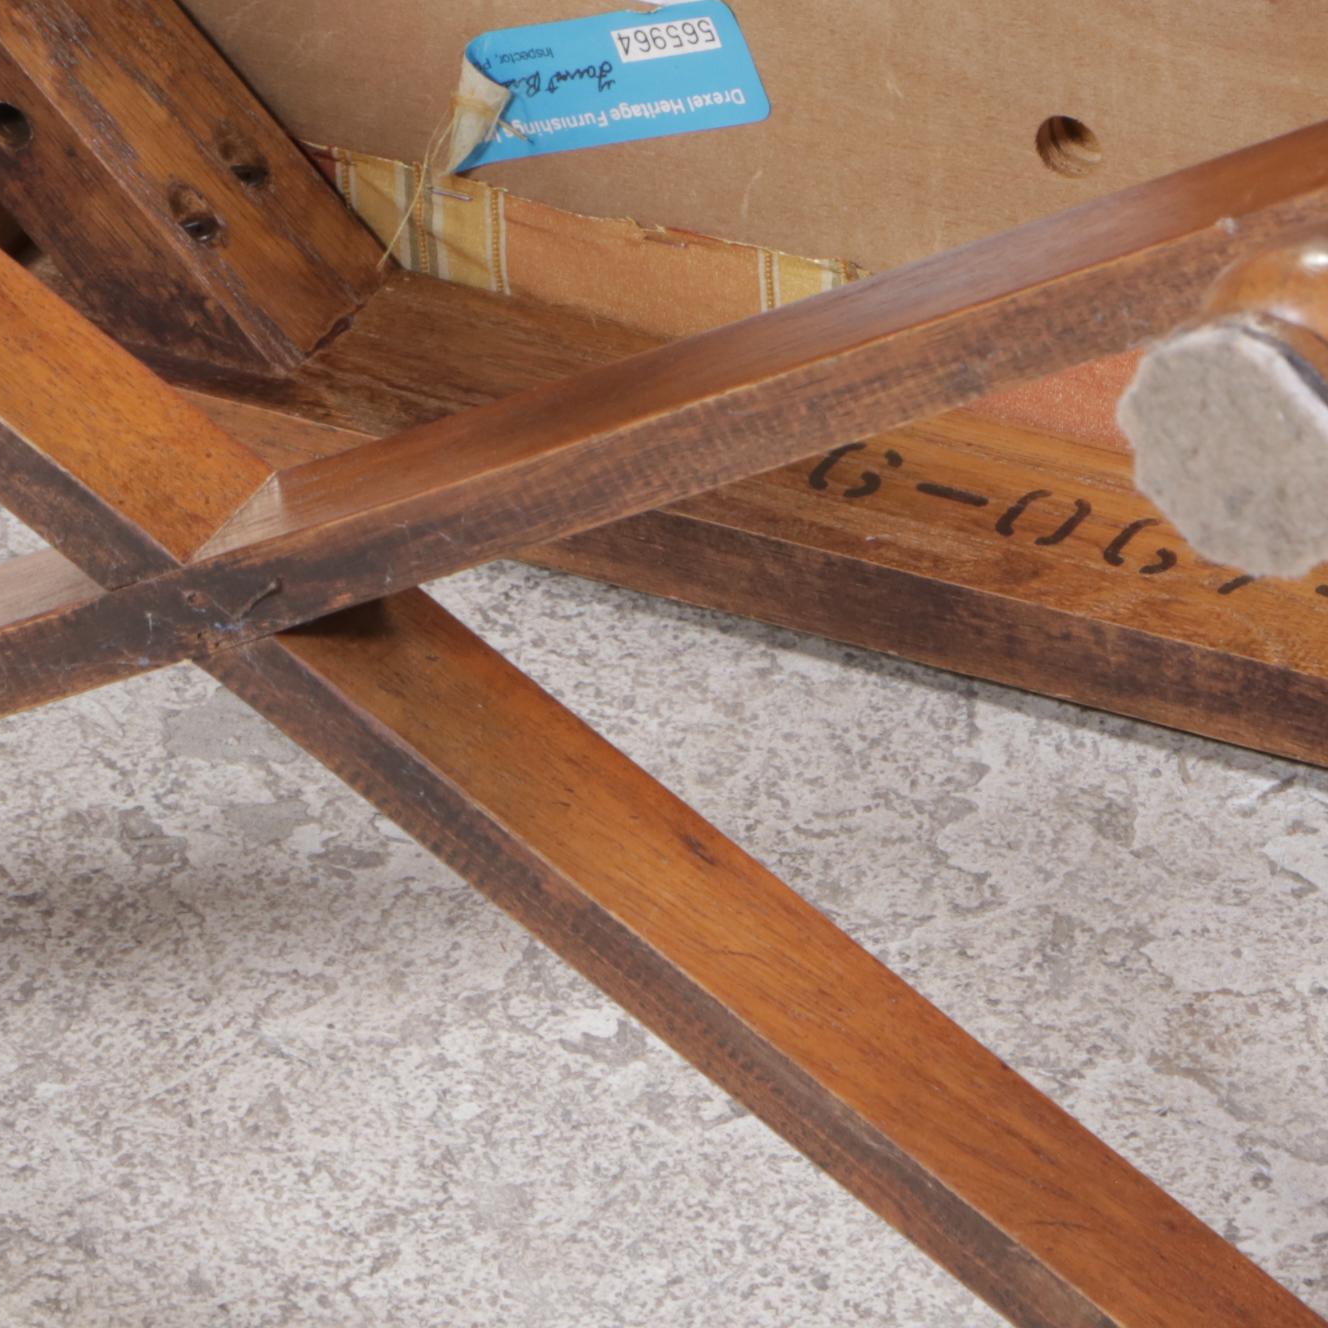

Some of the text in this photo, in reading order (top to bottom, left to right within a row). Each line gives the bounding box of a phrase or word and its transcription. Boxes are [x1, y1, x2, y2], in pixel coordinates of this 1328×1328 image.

[617, 19, 715, 57] 565964
[690, 87, 746, 108] Drexel
[612, 100, 685, 122] Heritage
